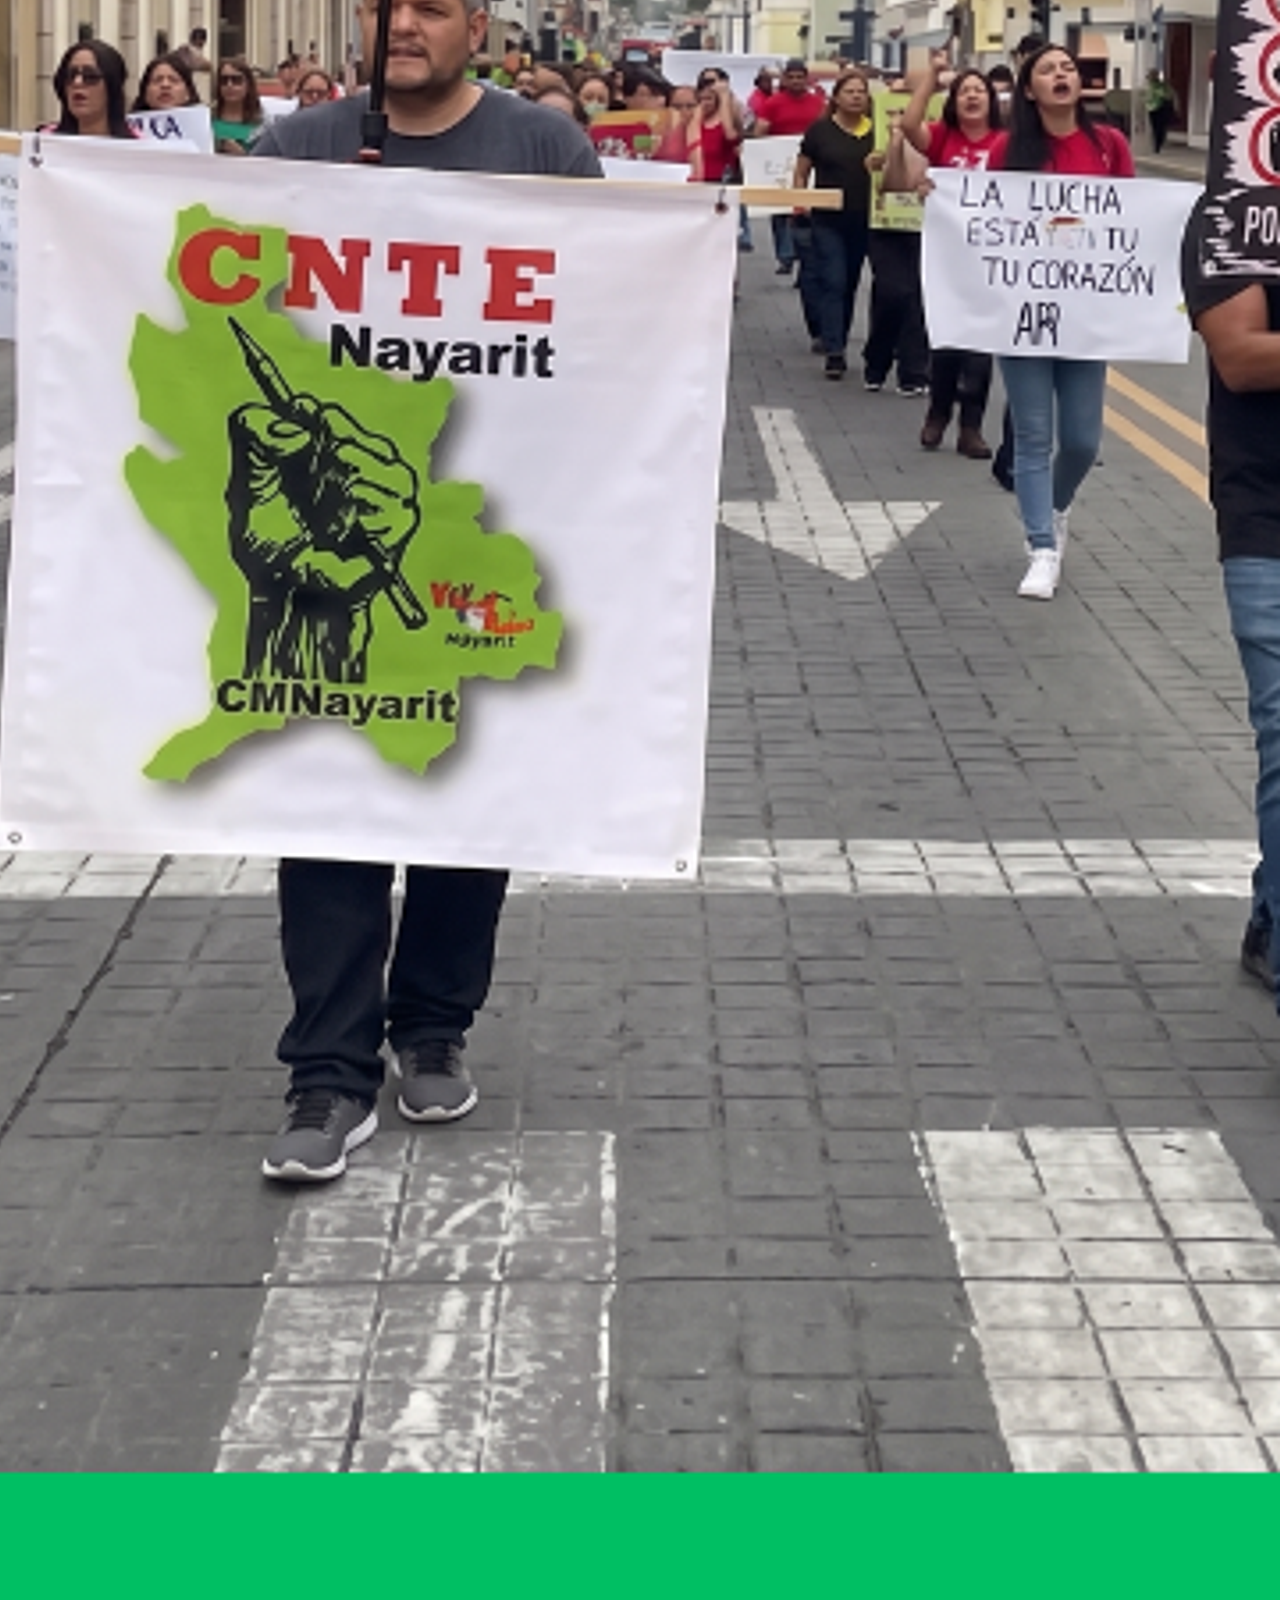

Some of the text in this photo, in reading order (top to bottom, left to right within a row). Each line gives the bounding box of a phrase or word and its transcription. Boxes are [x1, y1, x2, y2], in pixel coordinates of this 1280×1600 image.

[960, 176, 1122, 215] LA LUCHA
[178, 227, 557, 324] CNTE
[982, 255, 1155, 297] TU CORAZÓN
[329, 323, 556, 382] Nayarit
[217, 679, 458, 727] CMNayarit
